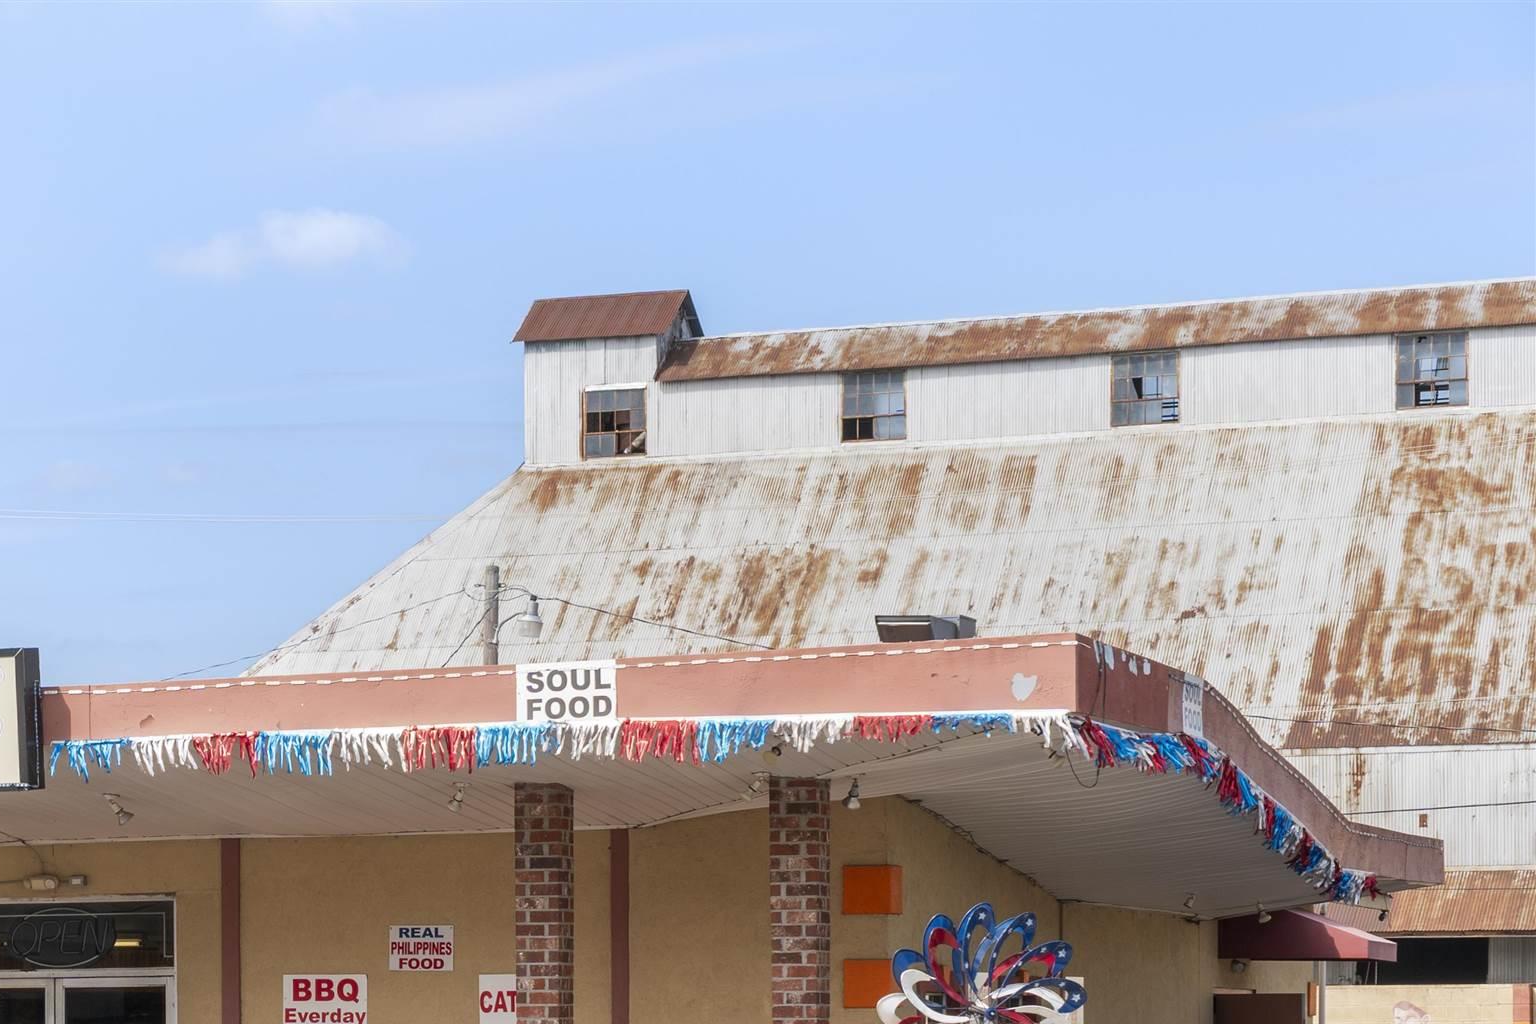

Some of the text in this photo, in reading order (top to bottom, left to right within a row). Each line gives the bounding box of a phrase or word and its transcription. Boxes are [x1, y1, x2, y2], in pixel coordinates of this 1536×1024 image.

[526, 668, 612, 693] SOUL
[526, 695, 612, 721] FOOD
[11, 919, 109, 956] OPEN
[398, 927, 444, 938] REAL
[391, 942, 452, 956] PHILIPPINES
[398, 958, 444, 969] FOOD
[292, 978, 359, 1003] BBQ
